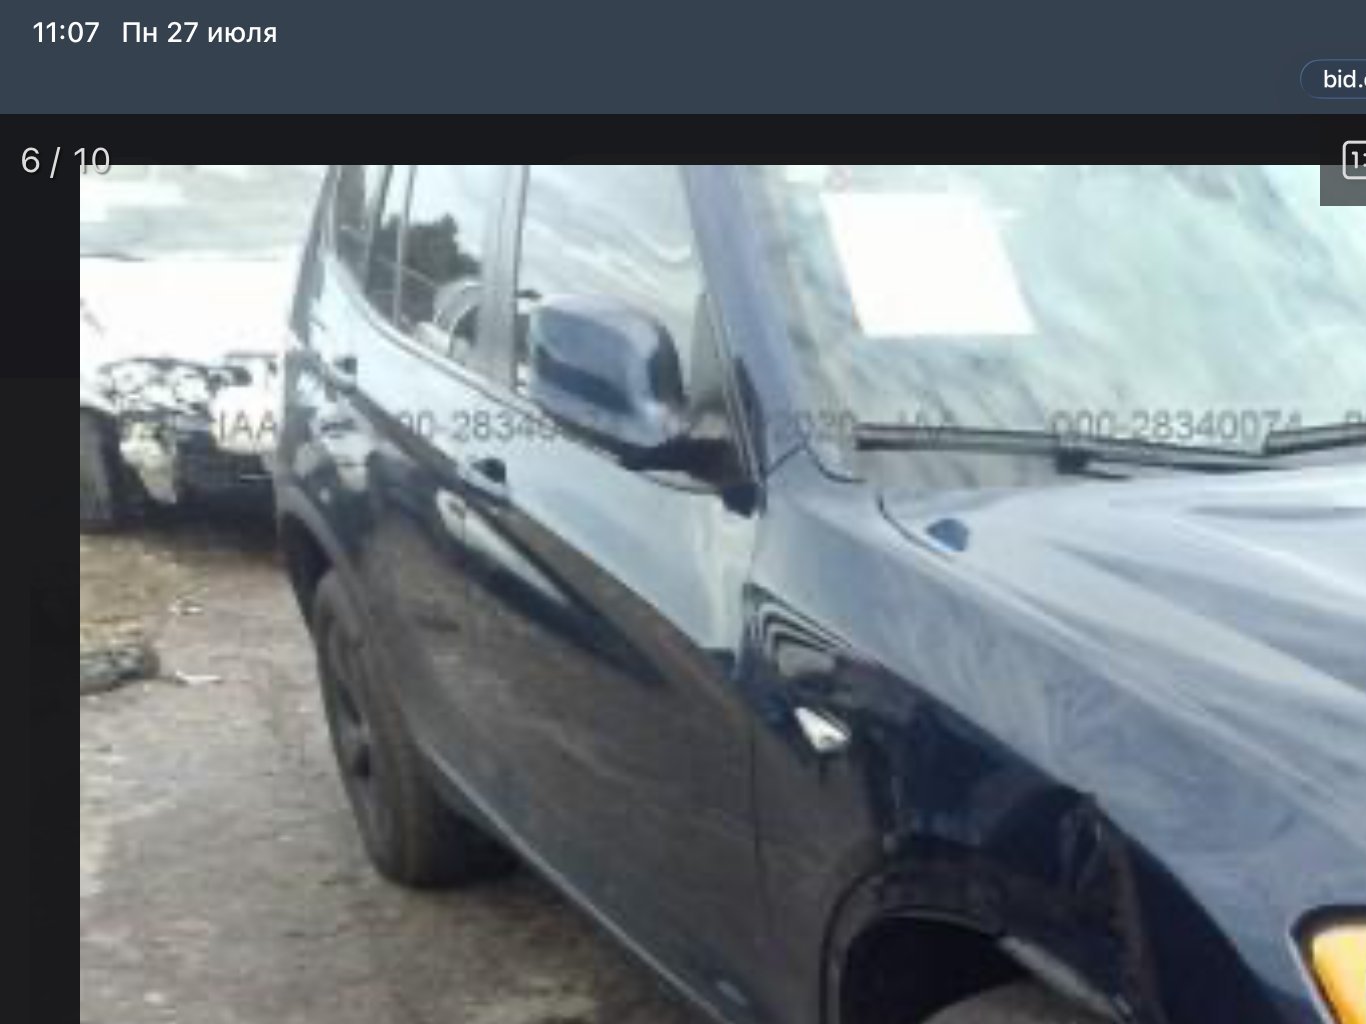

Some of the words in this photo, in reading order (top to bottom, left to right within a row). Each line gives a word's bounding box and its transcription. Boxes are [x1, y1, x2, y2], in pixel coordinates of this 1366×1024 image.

[33, 21, 99, 43] 11:07
[122, 21, 158, 43] Пн
[167, 21, 199, 43] 27
[208, 26, 278, 43] июля
[21, 147, 40, 173] 6
[49, 147, 61, 179] /
[73, 147, 111, 174] 10
